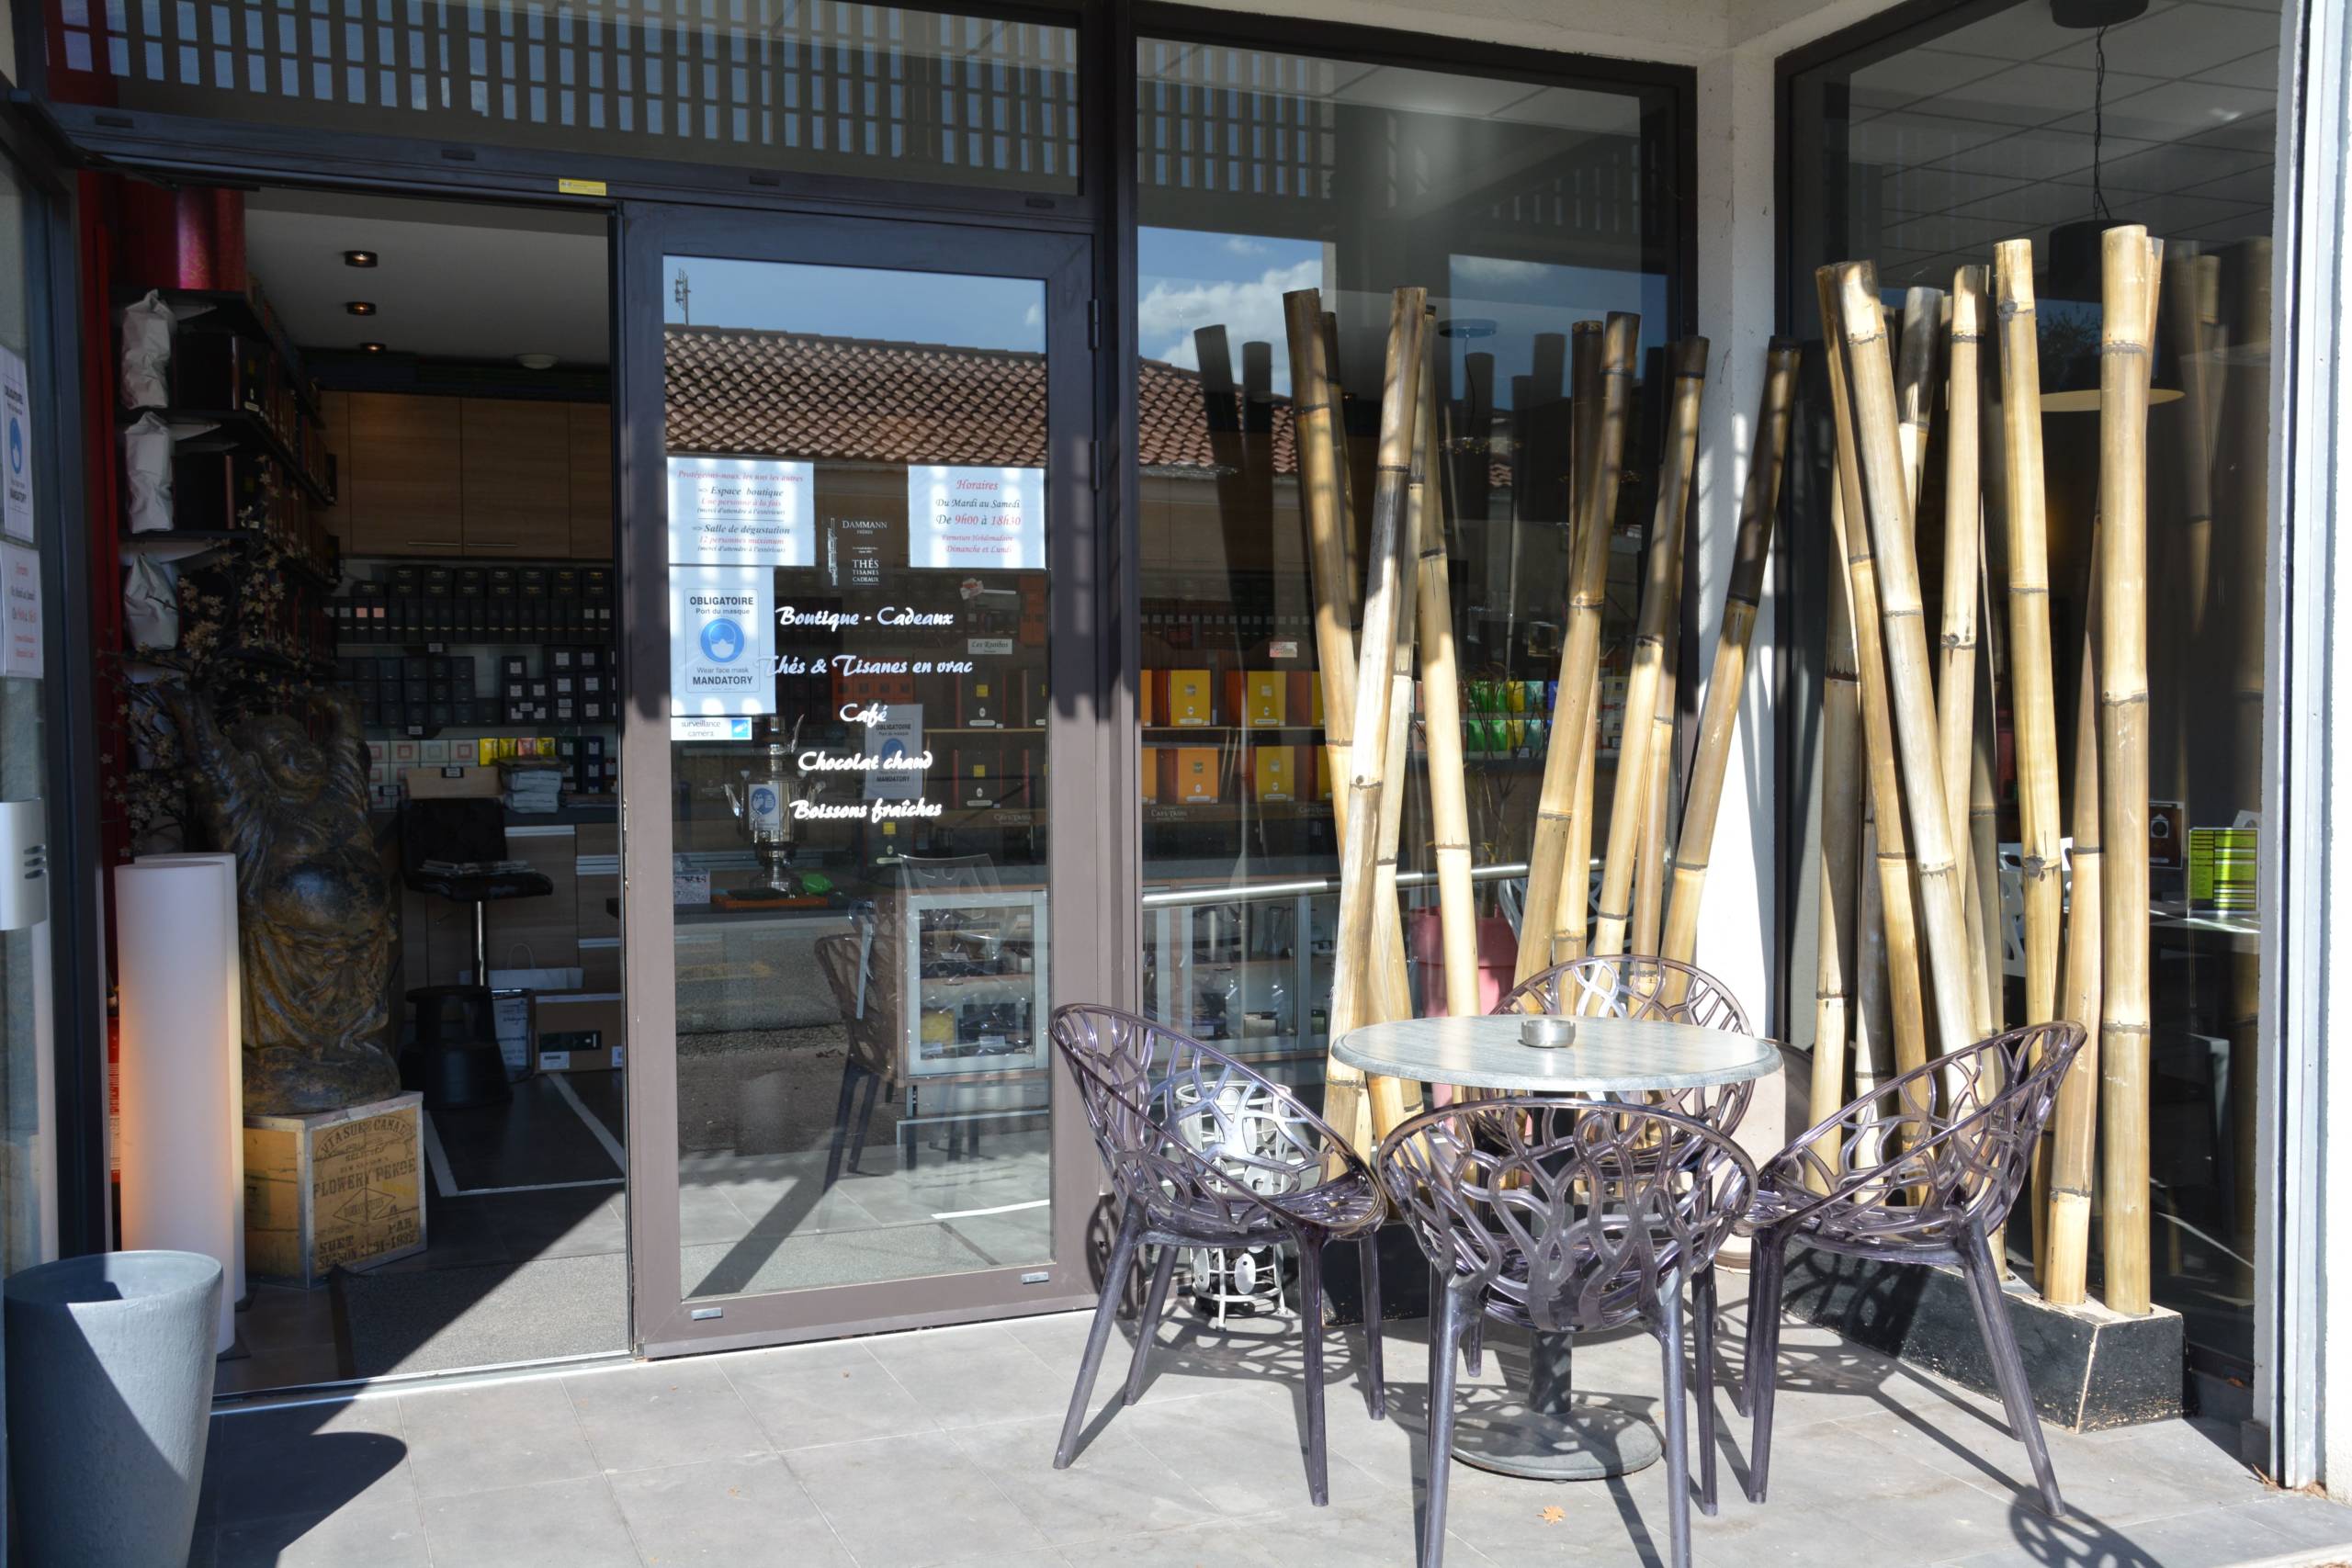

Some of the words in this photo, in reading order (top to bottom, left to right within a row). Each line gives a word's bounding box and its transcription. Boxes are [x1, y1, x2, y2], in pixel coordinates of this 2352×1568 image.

[956, 479, 999, 491] Horaires
[711, 487, 741, 496] Espace
[746, 487, 784, 498] boutique
[935, 498, 949, 507] Du
[951, 499, 978, 508] Mardi
[990, 499, 1020, 509] Samedi
[936, 514, 952, 525] De
[955, 514, 978, 525] 9h00
[980, 514, 988, 525] à
[990, 514, 1021, 525] 18h30
[704, 525, 726, 533] Salle
[728, 525, 738, 534] de
[741, 525, 790, 535] dégustation
[852, 558, 879, 569] THÉS
[690, 596, 754, 605] OBLIGATOIRE
[775, 606, 859, 632] Boutique
[876, 606, 954, 626] Cadeaux
[753, 654, 806, 677] Thés
[810, 659, 827, 673] &
[831, 654, 907, 677] Tisanes
[912, 662, 932, 673] en
[936, 661, 973, 673] vrac
[693, 676, 753, 685] MANDATORY
[840, 702, 888, 728] Café
[797, 750, 879, 771] Chocolat
[883, 750, 933, 770] chaud
[789, 799, 868, 819] Boissons
[871, 797, 943, 823] fraîches
[313, 1168, 371, 1200] FLOWERY
[375, 1158, 416, 1182] PEKOE
